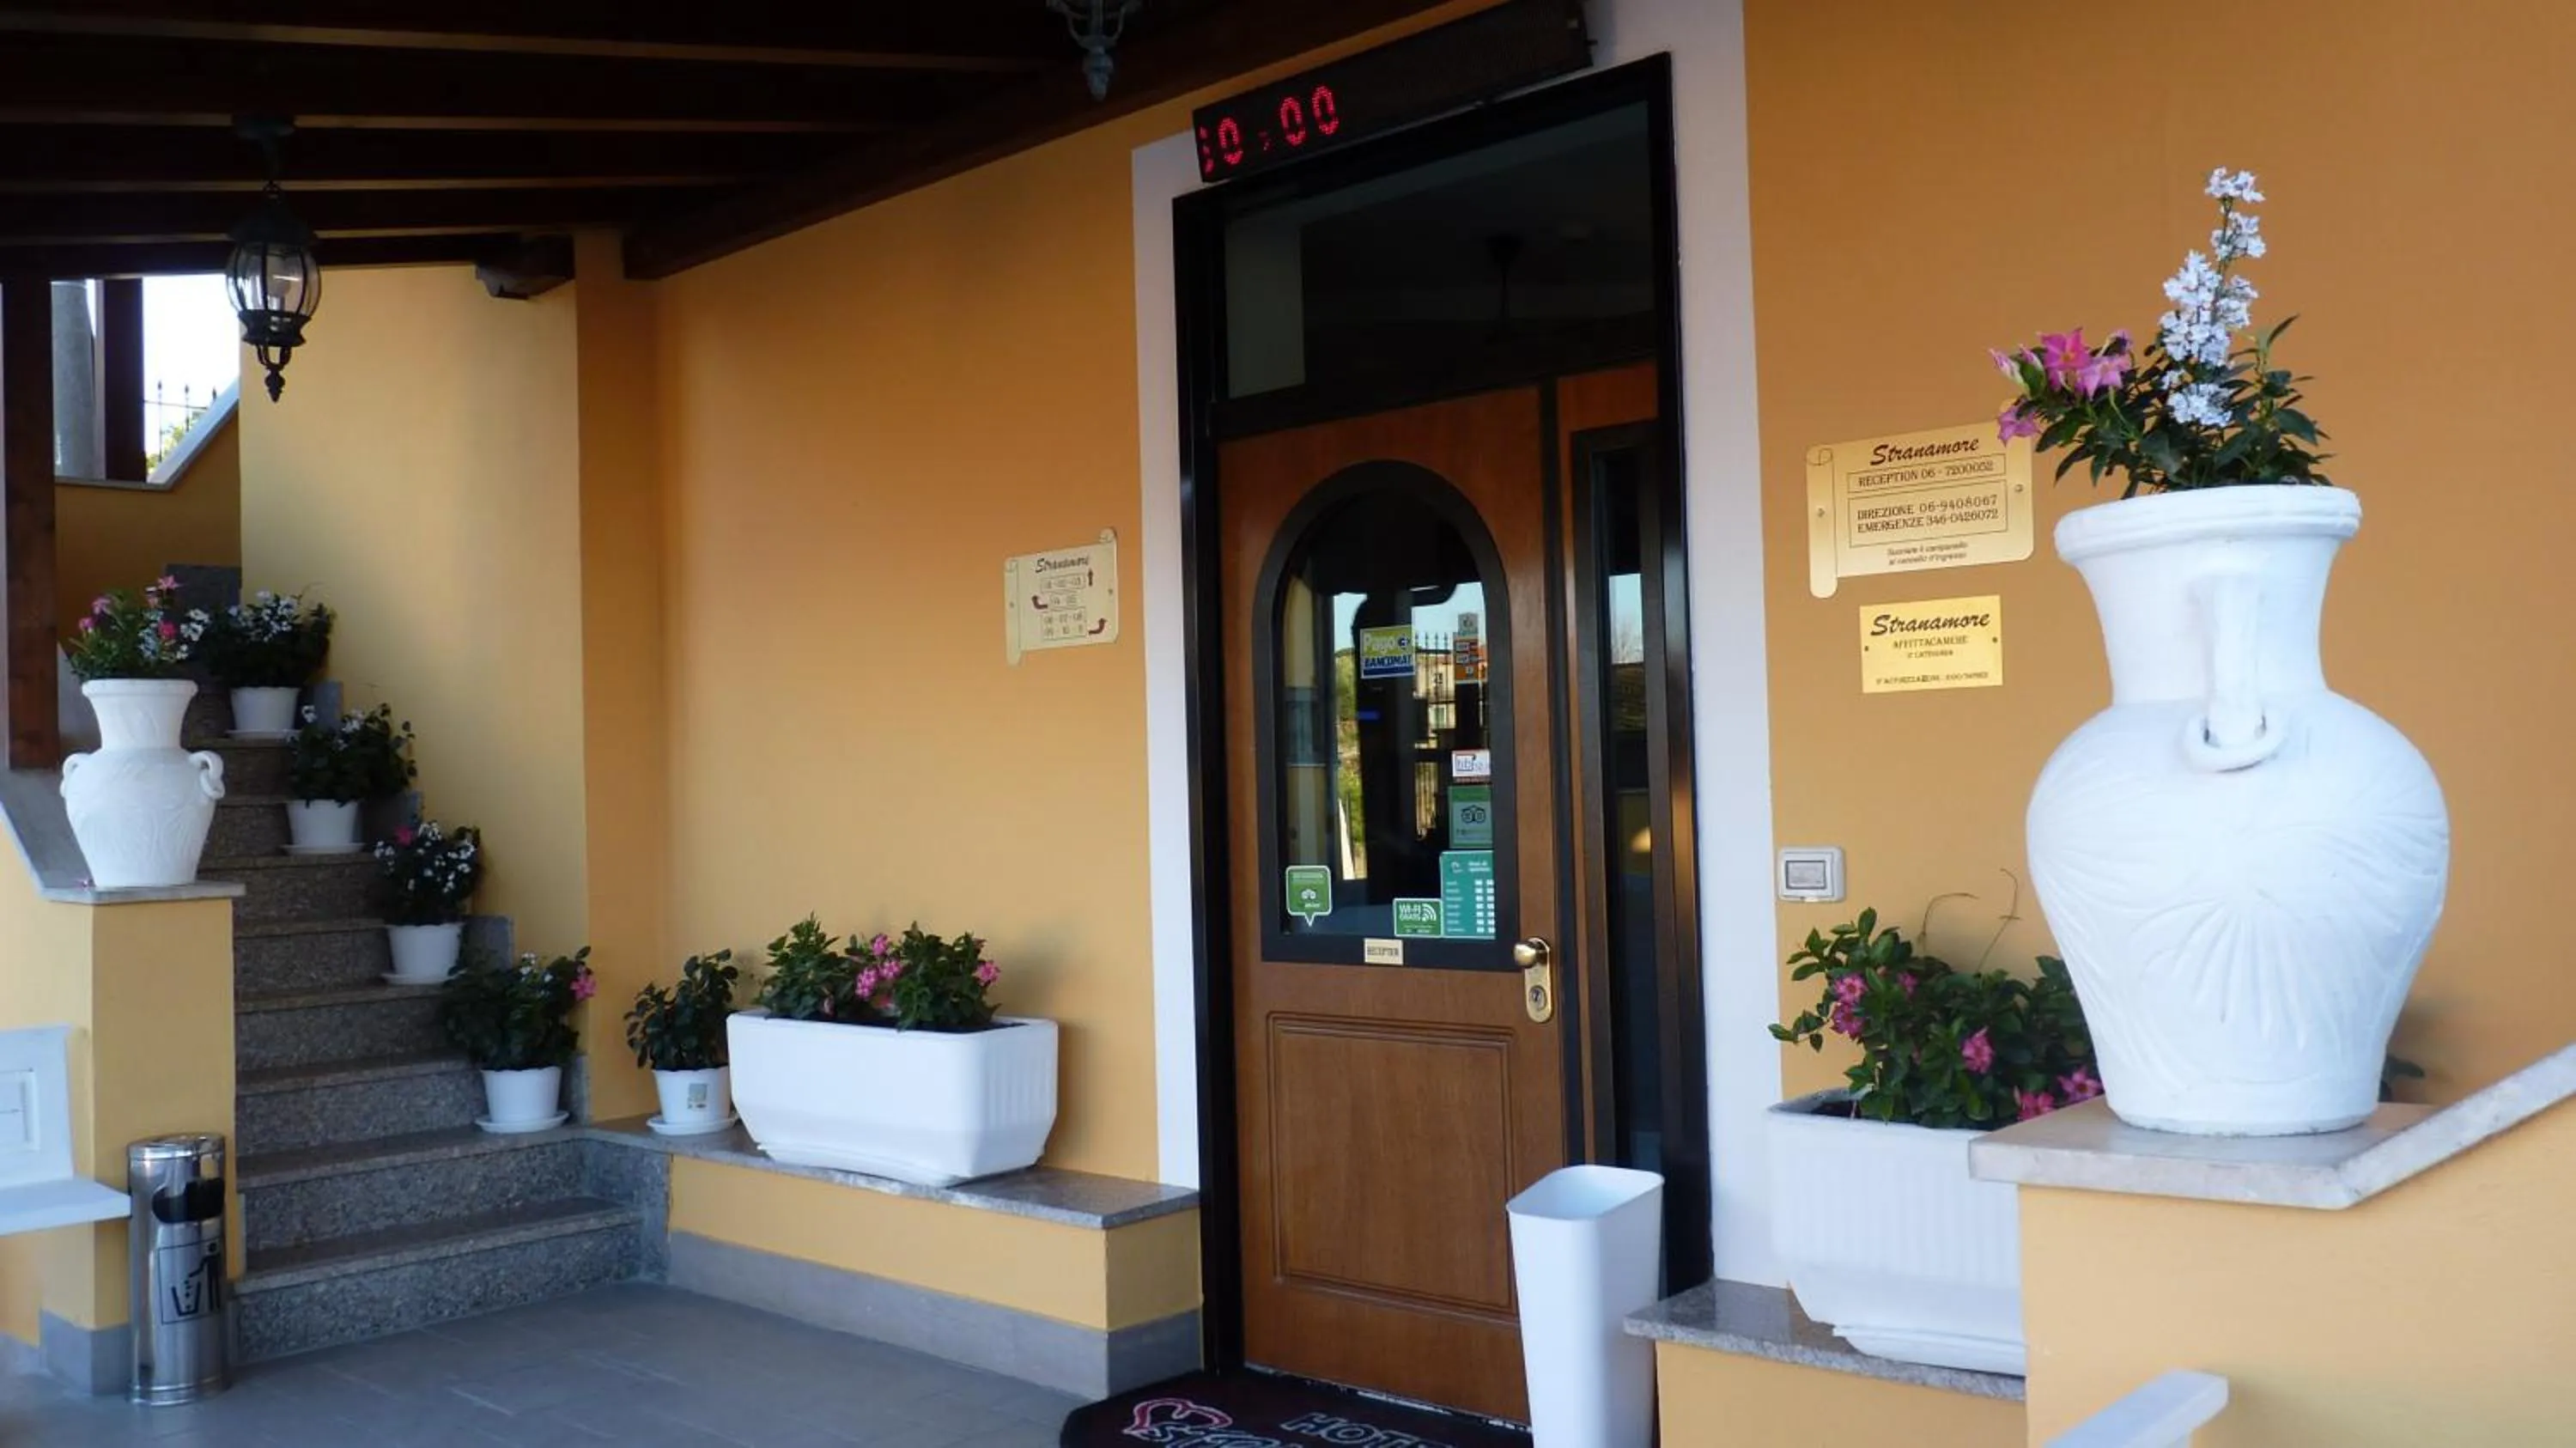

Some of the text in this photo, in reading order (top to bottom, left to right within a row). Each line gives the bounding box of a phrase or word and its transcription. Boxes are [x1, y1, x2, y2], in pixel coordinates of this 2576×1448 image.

[1869, 438, 1979, 466] Stranamore
[1858, 471, 1917, 488] RECEPTION
[1921, 469, 1935, 479] 06
[1857, 505, 1914, 520] DIREZIONE
[1857, 518, 1923, 533] EMERGENZE
[1870, 614, 1990, 636] Stranamore
[1364, 655, 1412, 667] BANCOMAT
